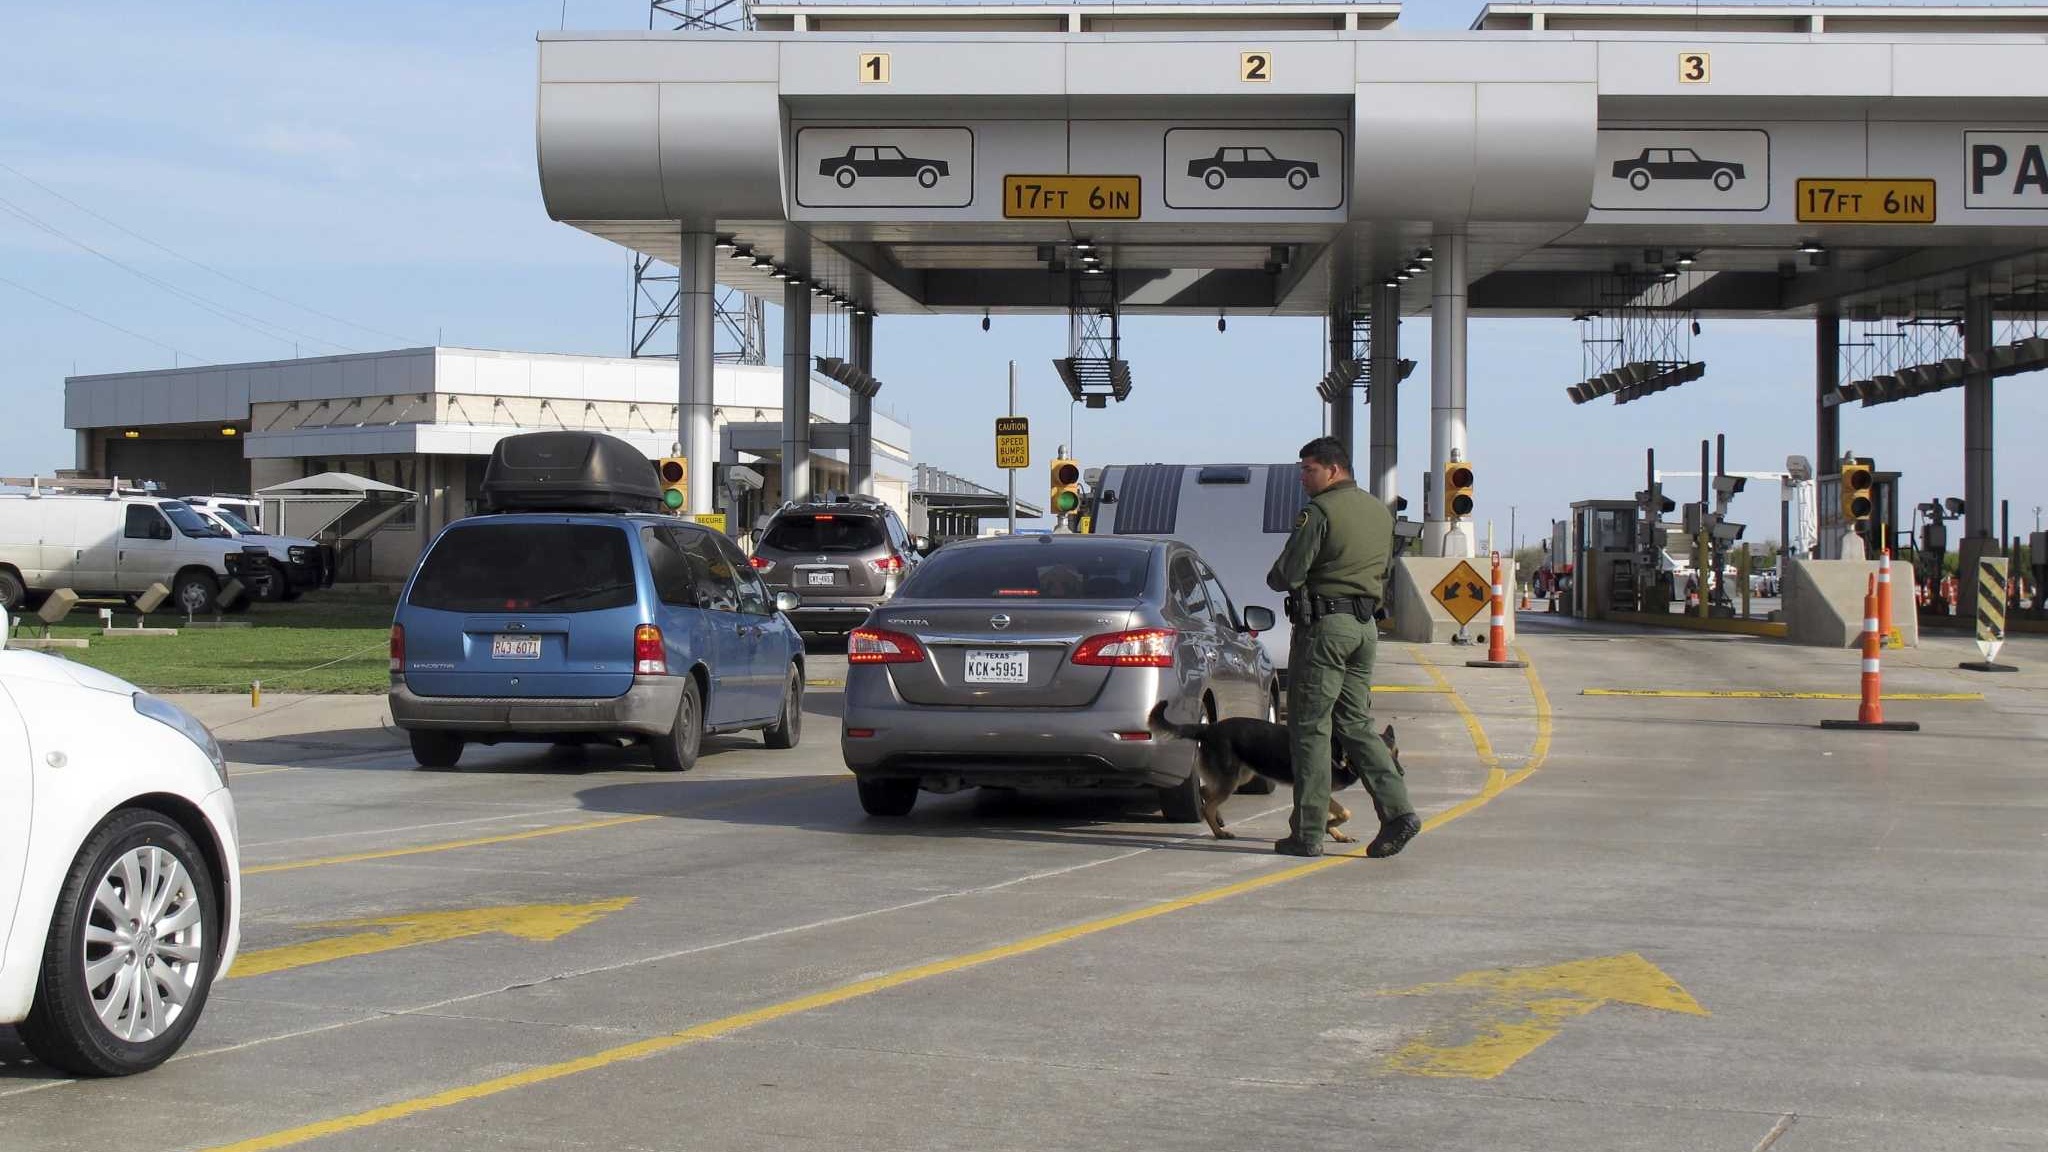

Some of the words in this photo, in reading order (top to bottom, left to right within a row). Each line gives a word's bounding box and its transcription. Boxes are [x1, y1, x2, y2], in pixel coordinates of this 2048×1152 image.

[867, 56, 882, 80] 1
[1247, 55, 1266, 80] 2
[1685, 56, 1704, 80] 3
[1089, 186, 1129, 210] 6IN
[1883, 190, 1924, 214] 6IN
[998, 422, 1026, 431] CAUTION
[1001, 437, 1024, 446] SPEED
[1000, 446, 1025, 455] BUMPS
[1001, 456, 1025, 464] AHEAD
[516, 641, 539, 655] 6071
[985, 652, 1010, 660] TEXAS
